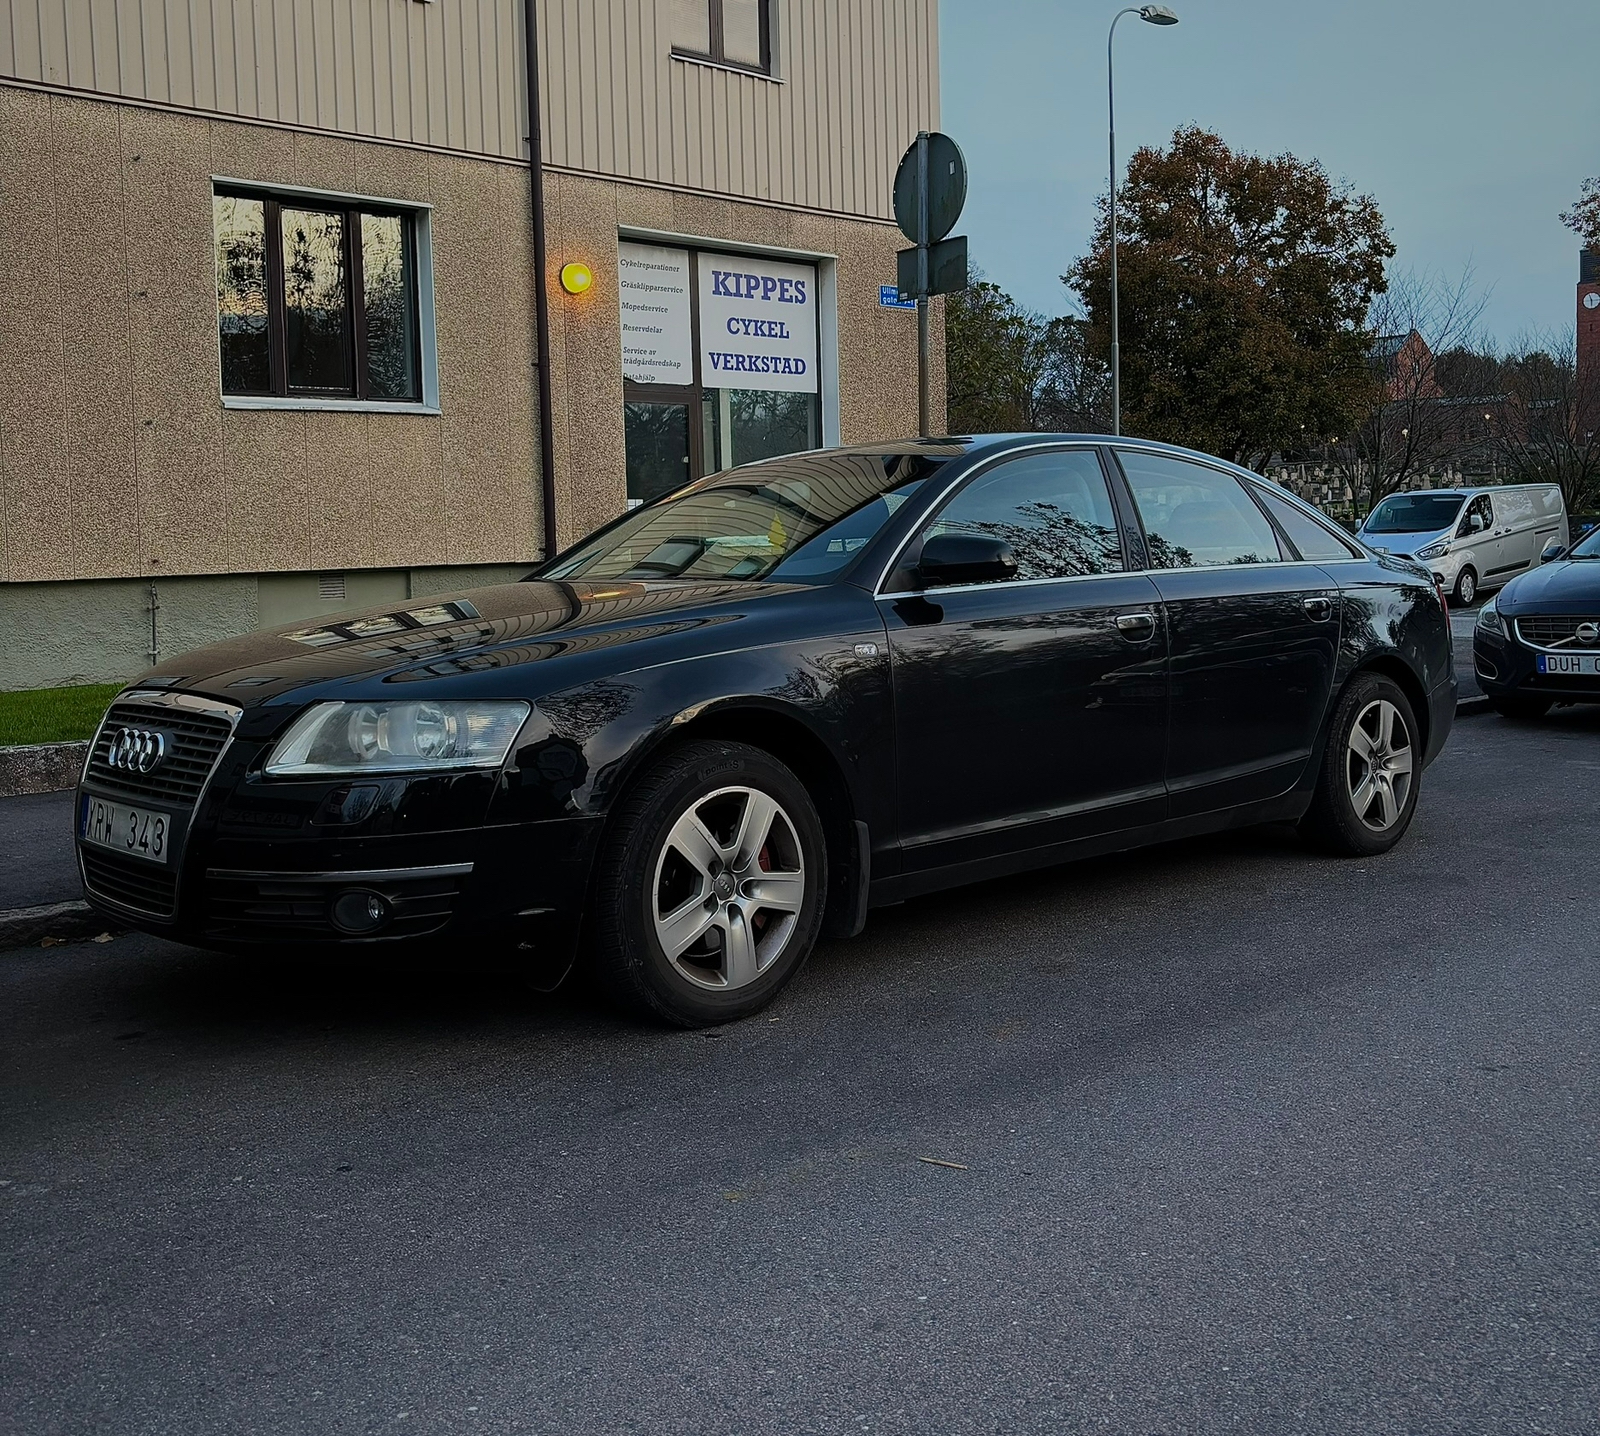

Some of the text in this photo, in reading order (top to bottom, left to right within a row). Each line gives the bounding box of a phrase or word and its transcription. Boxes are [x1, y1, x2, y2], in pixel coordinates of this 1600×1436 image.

[620, 259, 680, 272] Cykelreparationer
[621, 280, 684, 294] Gräsklipparservice
[711, 270, 807, 304] KIPPES
[621, 302, 669, 314] Mopedservice
[622, 323, 663, 334] Reservdelar
[726, 317, 790, 339] CYKEL
[622, 346, 657, 356] Service av
[623, 357, 682, 369] trädgårdsredskap
[708, 352, 807, 375] VERKSTAD
[1547, 656, 1581, 672] DUH
[126, 811, 166, 857] 343
